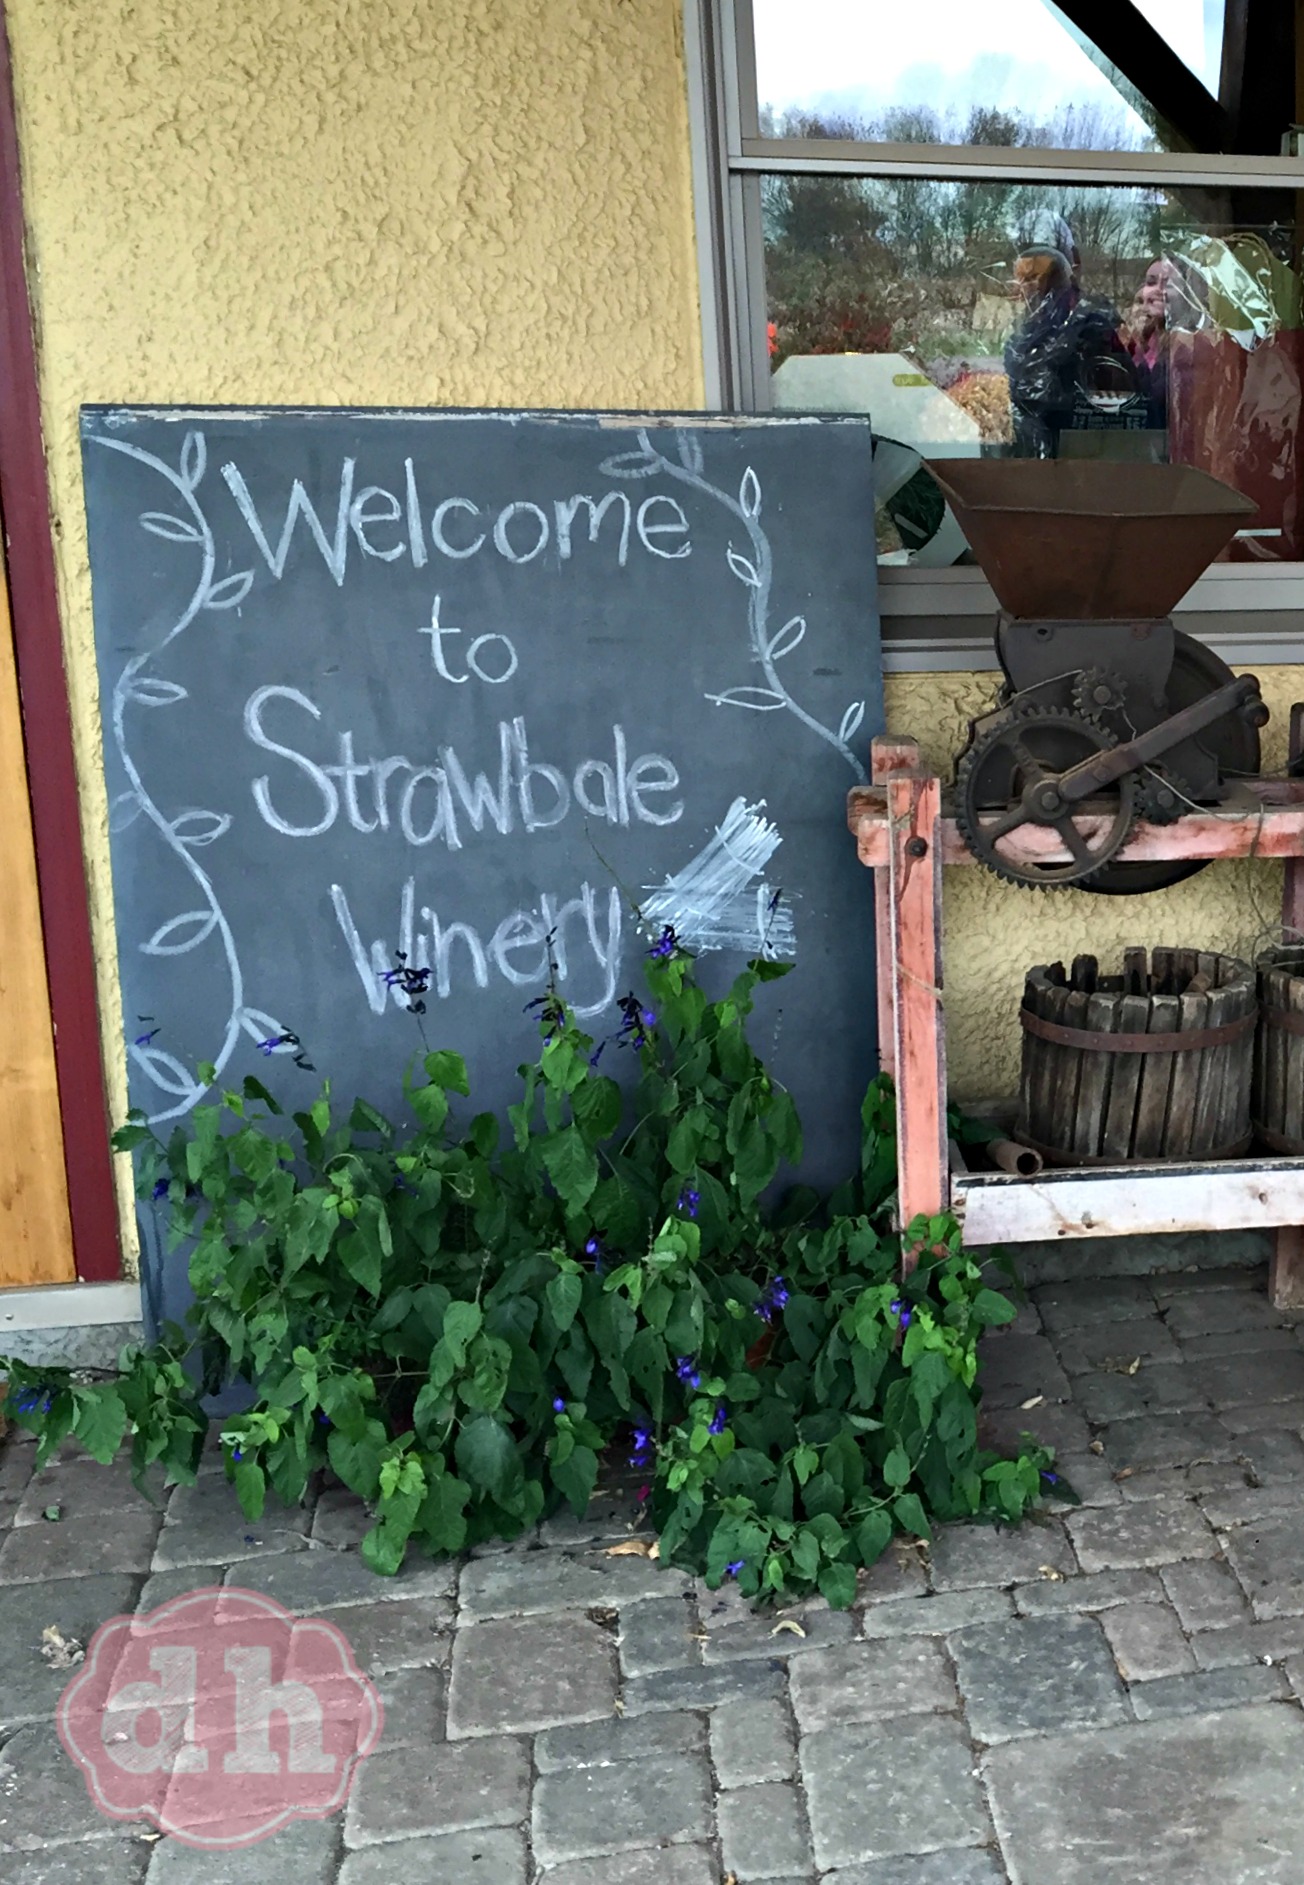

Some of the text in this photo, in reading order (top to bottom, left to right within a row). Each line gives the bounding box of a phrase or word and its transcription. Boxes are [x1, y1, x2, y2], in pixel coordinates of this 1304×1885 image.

[221, 456, 692, 586] Welcome
[417, 594, 518, 684] to
[243, 684, 684, 851] Strawbale
[328, 875, 622, 1018] Winery
